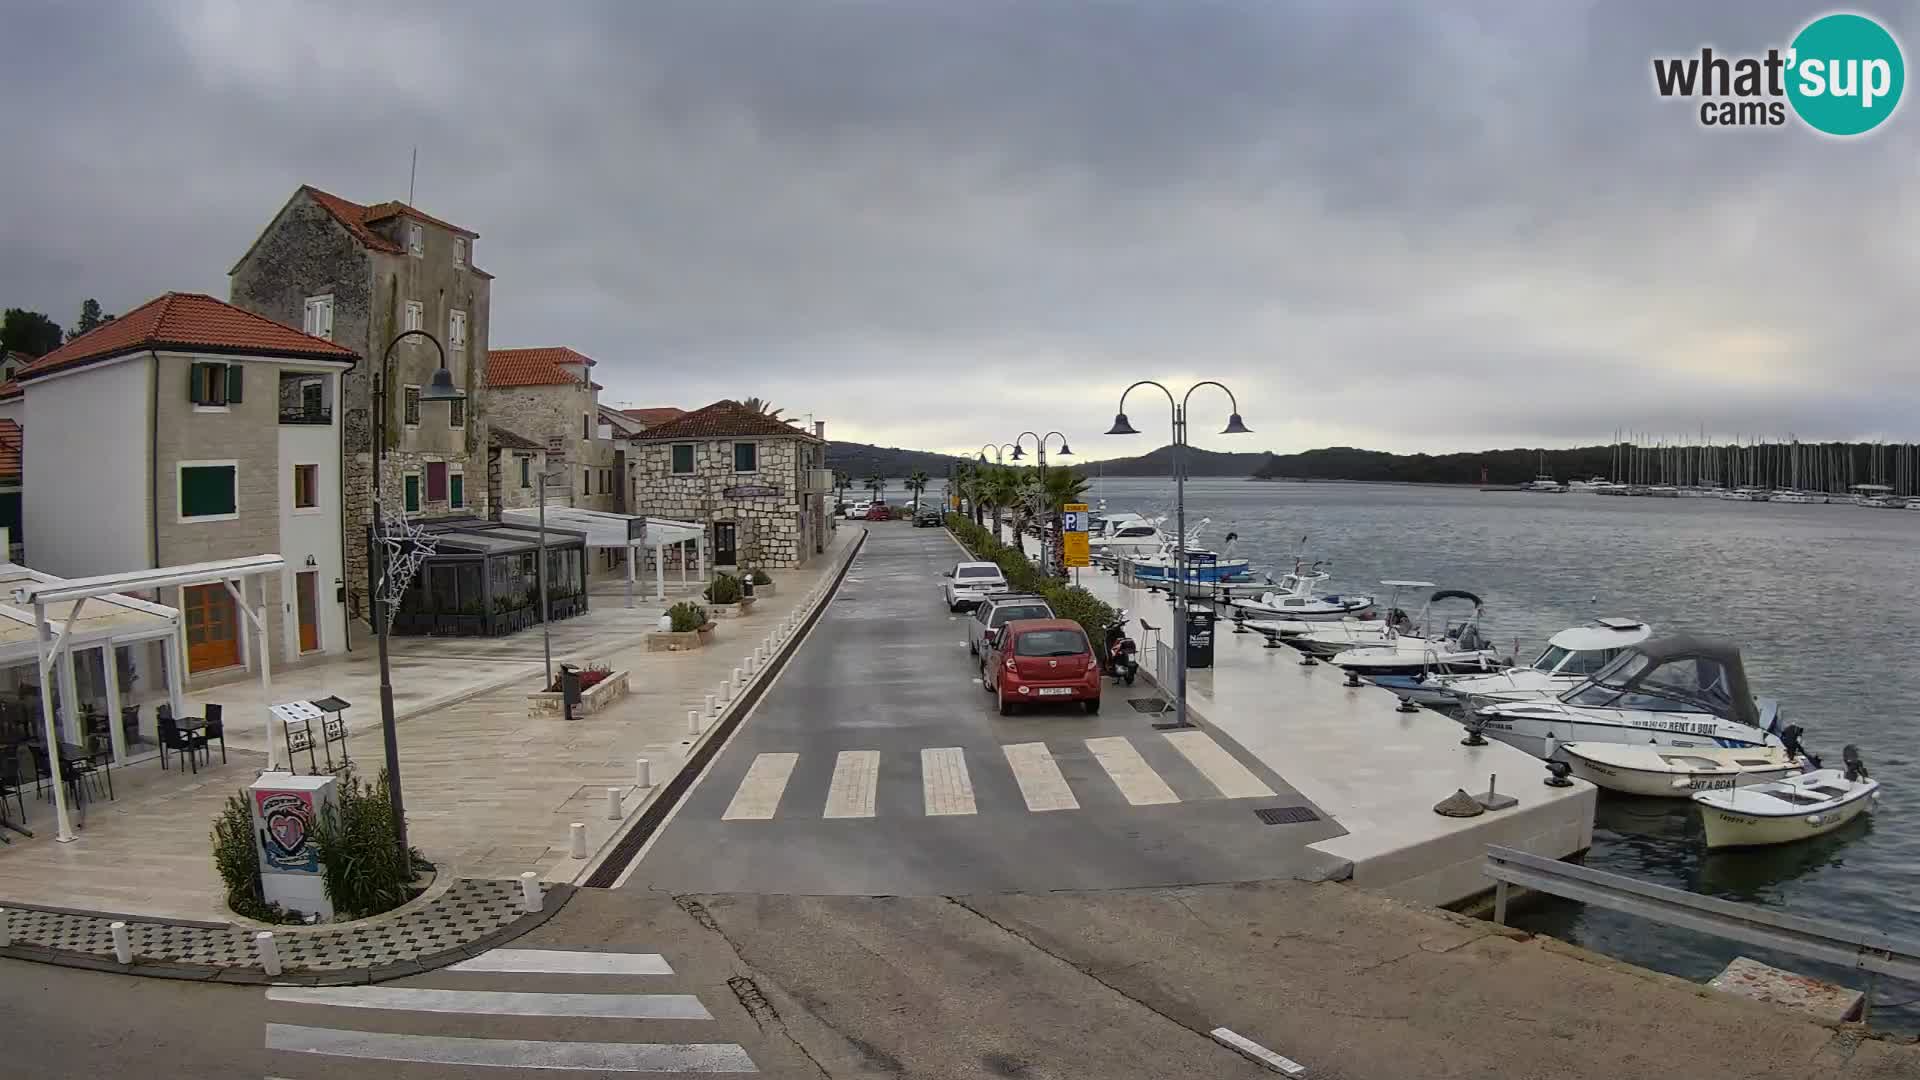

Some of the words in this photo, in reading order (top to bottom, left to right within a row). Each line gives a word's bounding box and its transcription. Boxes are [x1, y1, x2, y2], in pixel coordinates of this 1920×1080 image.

[1066, 514, 1076, 529] P
[1669, 721, 1690, 732] RENT
[1690, 722, 1696, 732] A
[1697, 723, 1718, 736] BOAT
[1706, 780, 1713, 790] A
[1715, 778, 1736, 790] BOAT
